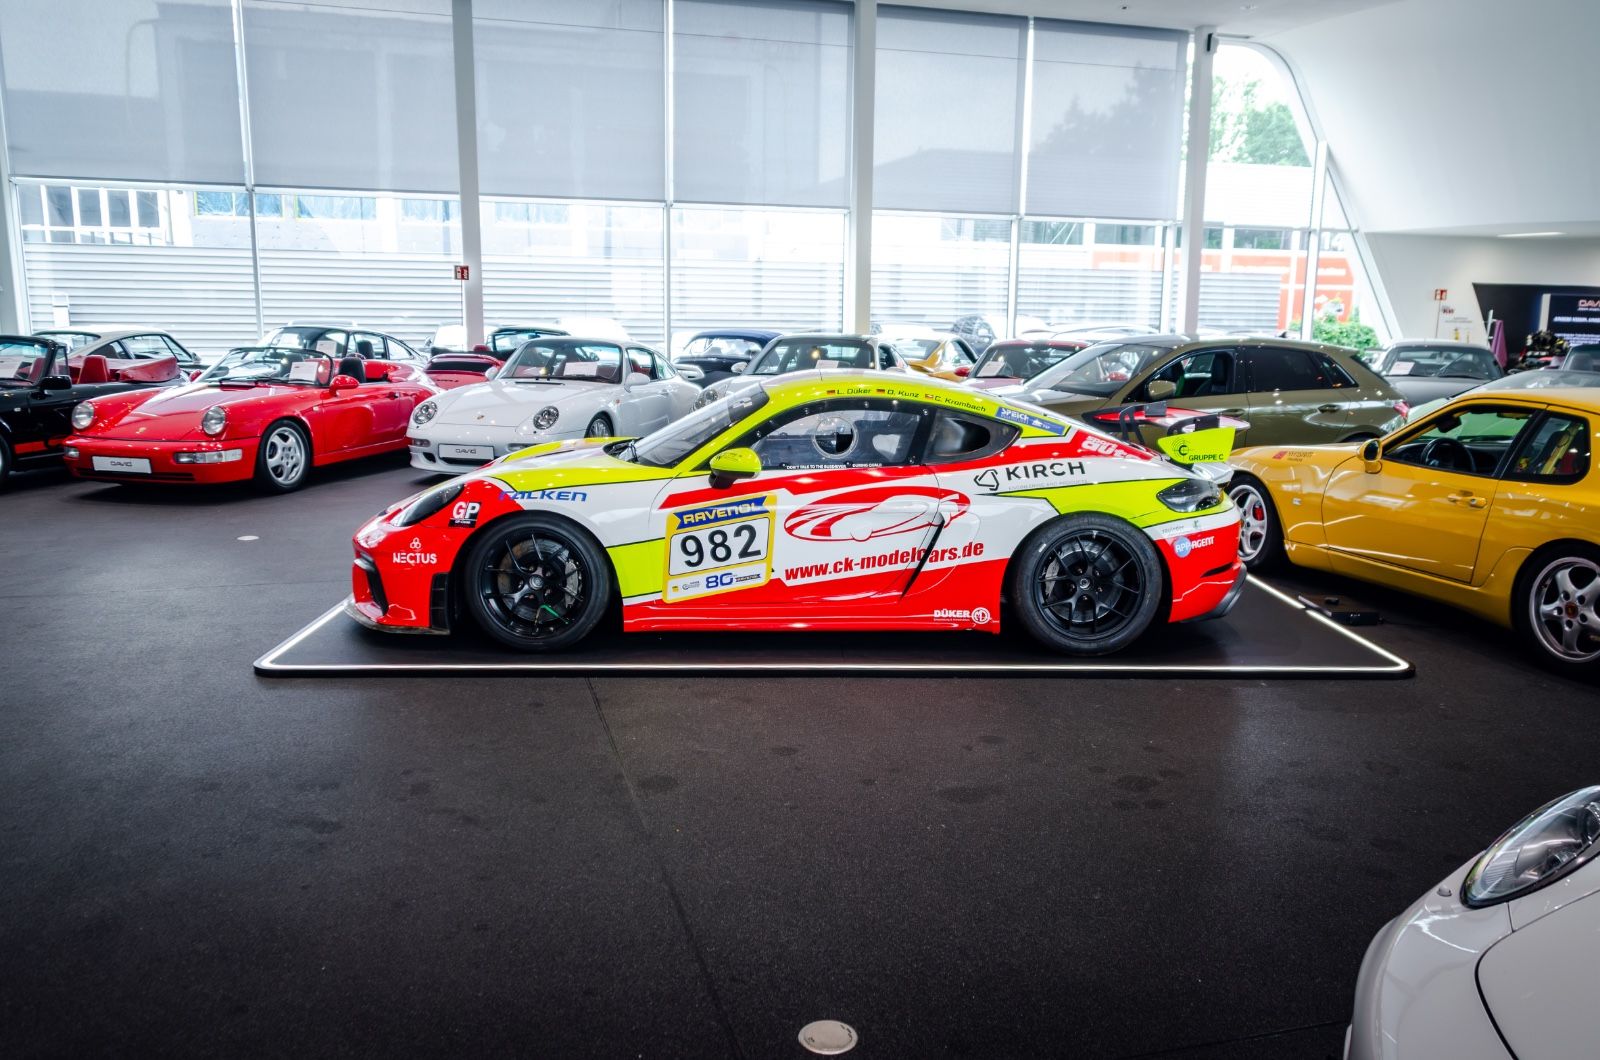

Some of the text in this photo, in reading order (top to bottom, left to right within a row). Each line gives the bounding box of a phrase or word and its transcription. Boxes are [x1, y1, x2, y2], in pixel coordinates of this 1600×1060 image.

[1578, 299, 1600, 307] DAV
[898, 390, 920, 398] Kunz
[944, 398, 987, 412] Krombach
[1005, 461, 1086, 481] KIRCH
[499, 490, 587, 502] FALKEN
[452, 501, 480, 519] GP
[682, 502, 761, 525] RAVENOL
[680, 524, 762, 568] 982
[392, 552, 438, 566] NECTUS
[784, 541, 985, 581] www.ck-modelcars.de
[933, 608, 971, 619] DÜKER
